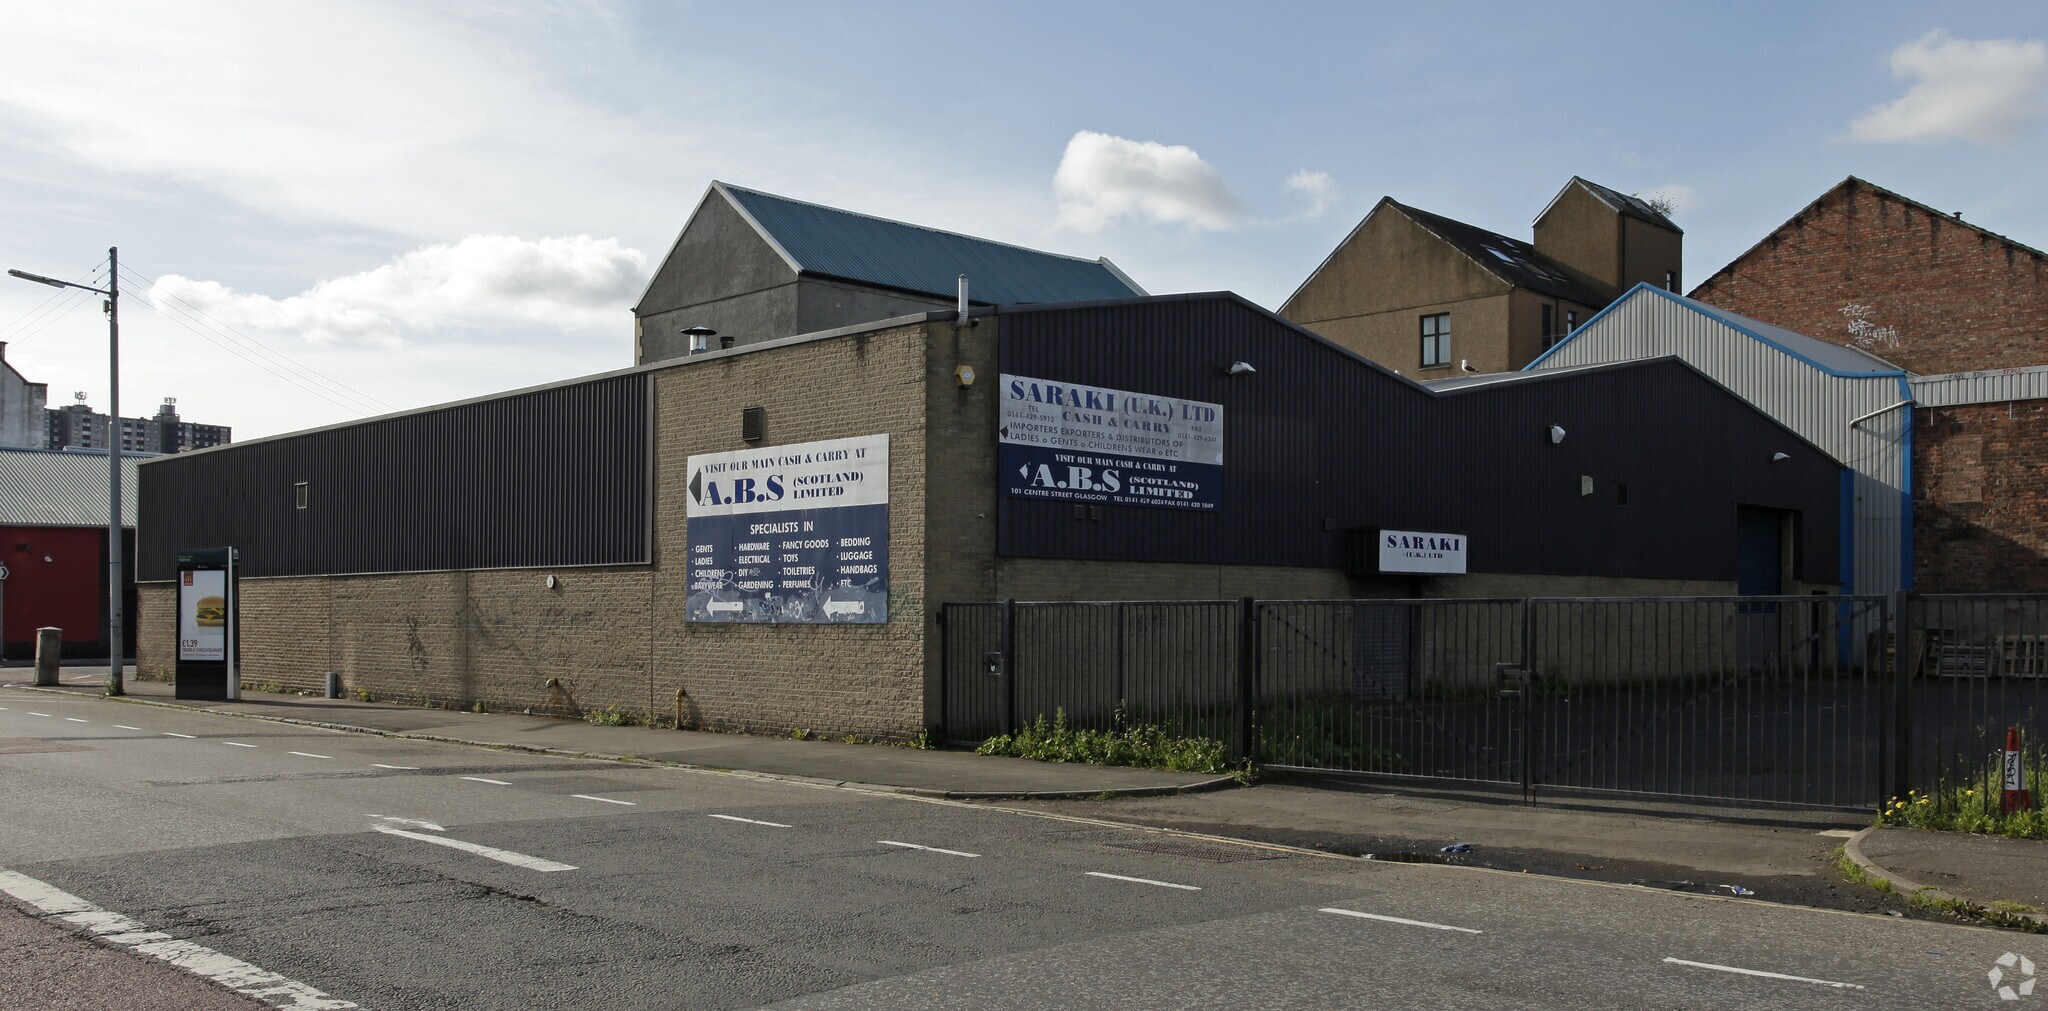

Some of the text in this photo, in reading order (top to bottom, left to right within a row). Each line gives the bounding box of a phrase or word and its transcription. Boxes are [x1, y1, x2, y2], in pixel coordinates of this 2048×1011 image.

[1010, 380, 1215, 423] SARAKI (U.K.) LTD
[1062, 411, 1170, 433] CASH & CARRY
[1010, 422, 1058, 434] IMPORTERS
[1061, 428, 1105, 439] EXPORTERS
[1117, 434, 1170, 446] DISTRIBUTORS
[1172, 440, 1184, 448] OF
[1010, 432, 1040, 443] LADIES
[1051, 436, 1078, 447] GENTS
[1089, 441, 1132, 452] CHILDRENS
[1135, 446, 1156, 455] WEAR
[705, 447, 867, 474] VISIT OUR MAIN CASH & CARRY AT
[1055, 453, 1177, 473] VISIT OUR MAIN CASH & CARRY AT
[1030, 463, 1199, 493] A.B.S (SCOTLAND)
[701, 471, 864, 506] A.B.S (SCOTLAND)
[793, 486, 844, 499] LIMITED
[1129, 485, 1193, 499] LIMITED
[1074, 492, 1108, 501] GLASGOW
[750, 521, 814, 535] SPECIALISTS IN
[738, 542, 770, 551] HARDWARE
[782, 539, 829, 550] FANCY GOODS
[840, 537, 871, 547] BEDDING
[1387, 534, 1460, 551] SARAKI
[695, 544, 713, 553] GENTS
[738, 555, 770, 564] ELECTRICAL
[783, 553, 799, 562] TOYS
[840, 551, 873, 560] LUGGAGE
[695, 556, 713, 566] LADIES
[694, 569, 725, 578] CHILDRENS
[738, 568, 749, 577] DIY
[783, 566, 815, 575] TOILETRIES
[840, 564, 878, 574] HANDBAGS
[694, 581, 723, 590] BABYWEAR
[738, 580, 774, 589] GARDENING
[782, 580, 811, 589] PERFUMES
[182, 639, 198, 648] £1.39
